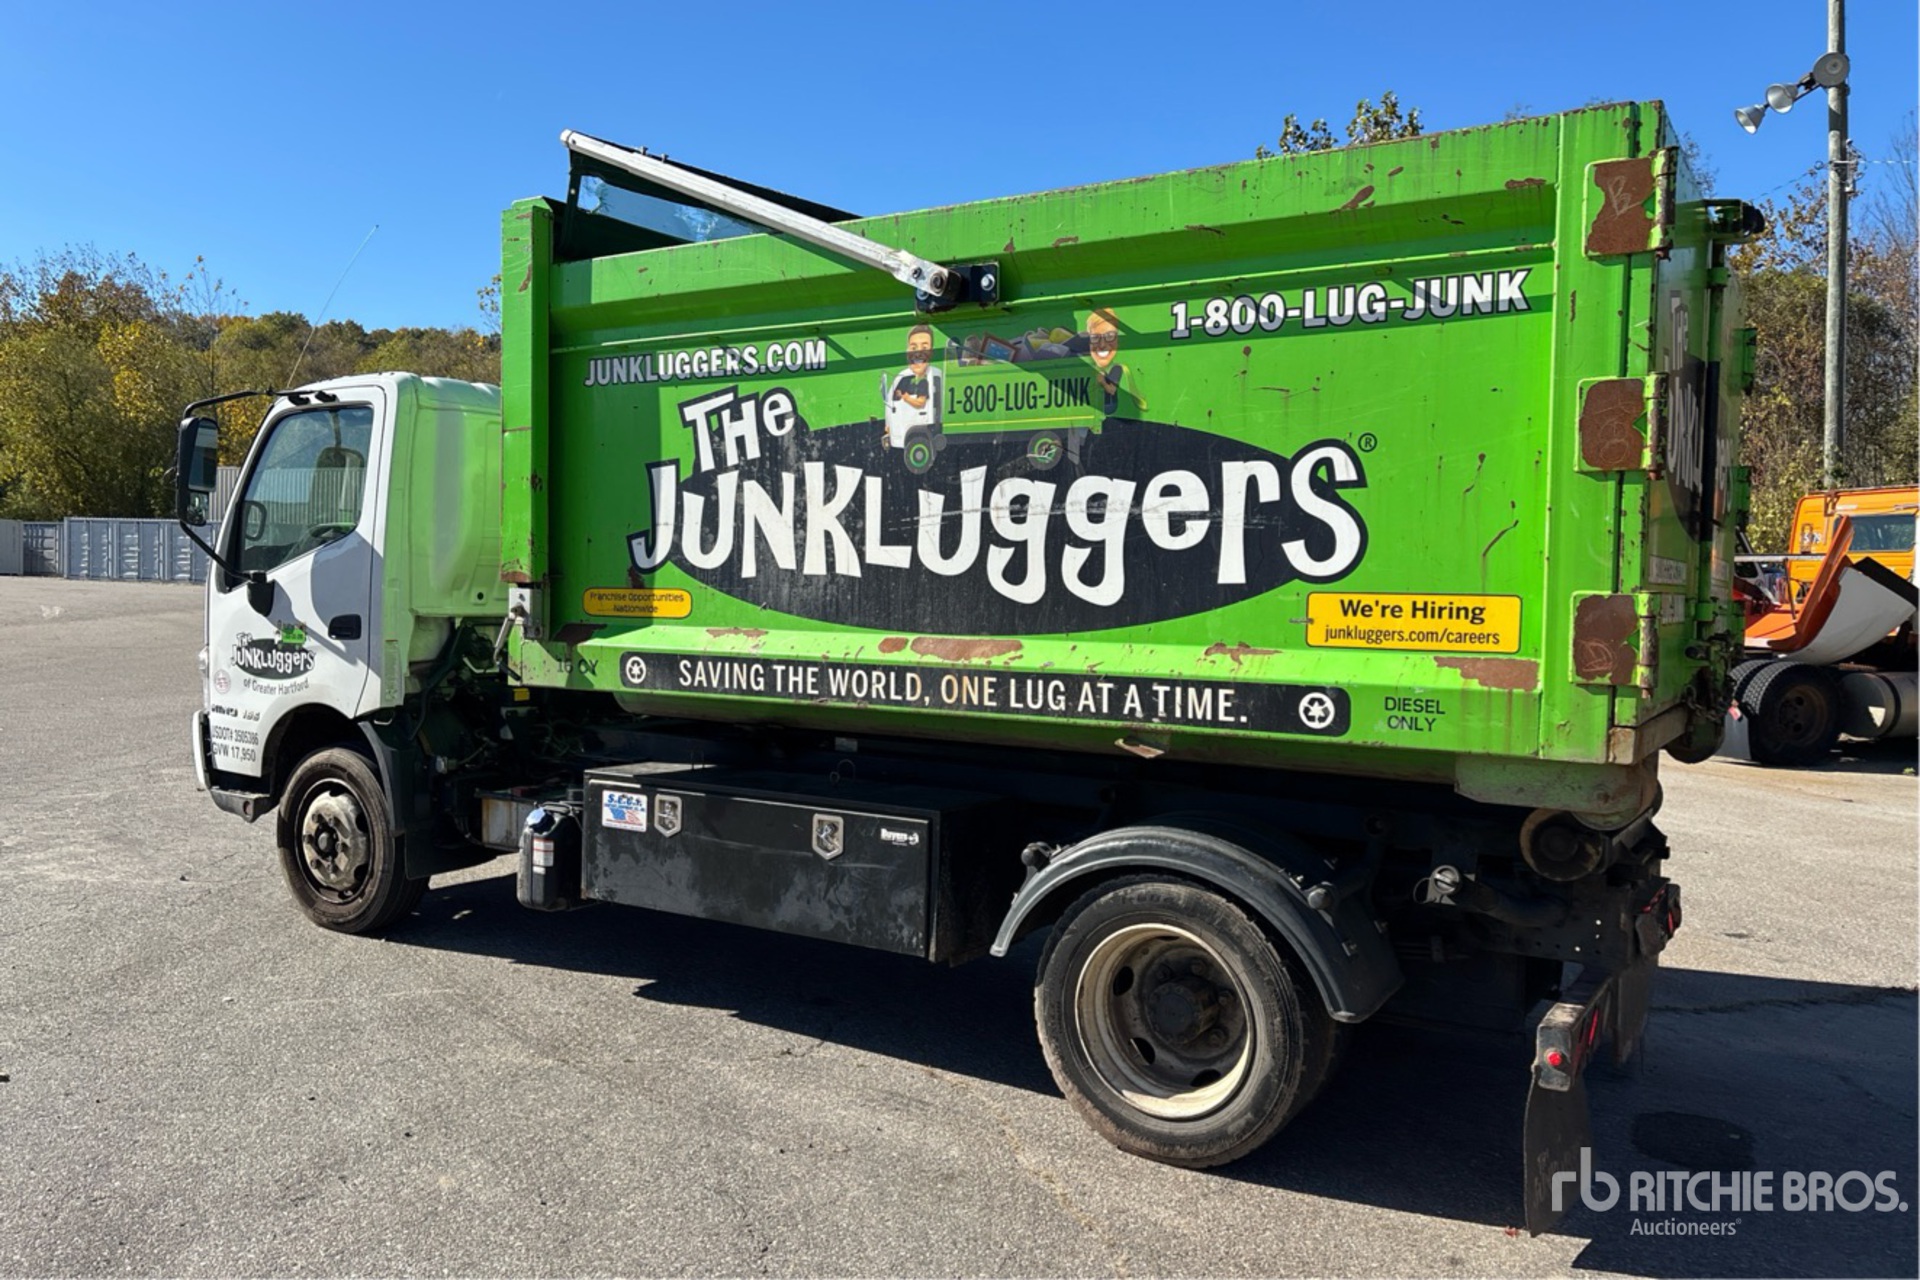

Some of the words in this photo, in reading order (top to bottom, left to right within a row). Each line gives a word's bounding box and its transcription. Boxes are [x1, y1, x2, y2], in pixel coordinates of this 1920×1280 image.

[1170, 268, 1532, 340] 1-800-LUG-JUNK
[584, 338, 827, 386] JUNKLUGGERS.COM
[948, 377, 1091, 414] 1-800-LUG-JUNK
[1340, 598, 1404, 619] We're
[1411, 600, 1486, 625] Hiring
[1324, 624, 1500, 645] junkluggers.com/careers
[252, 679, 277, 695] Greater
[278, 678, 309, 695] Hartford
[679, 659, 765, 691] SAVING
[772, 665, 819, 695] THE
[828, 668, 930, 706] WORLD,
[940, 674, 998, 706] ONE
[1009, 678, 1066, 711] LUG
[1077, 682, 1115, 713] AT
[1122, 684, 1143, 716] A
[1151, 685, 1248, 723] TIME.
[1384, 696, 1446, 715] DIESEL
[1387, 716, 1437, 732] ONLY
